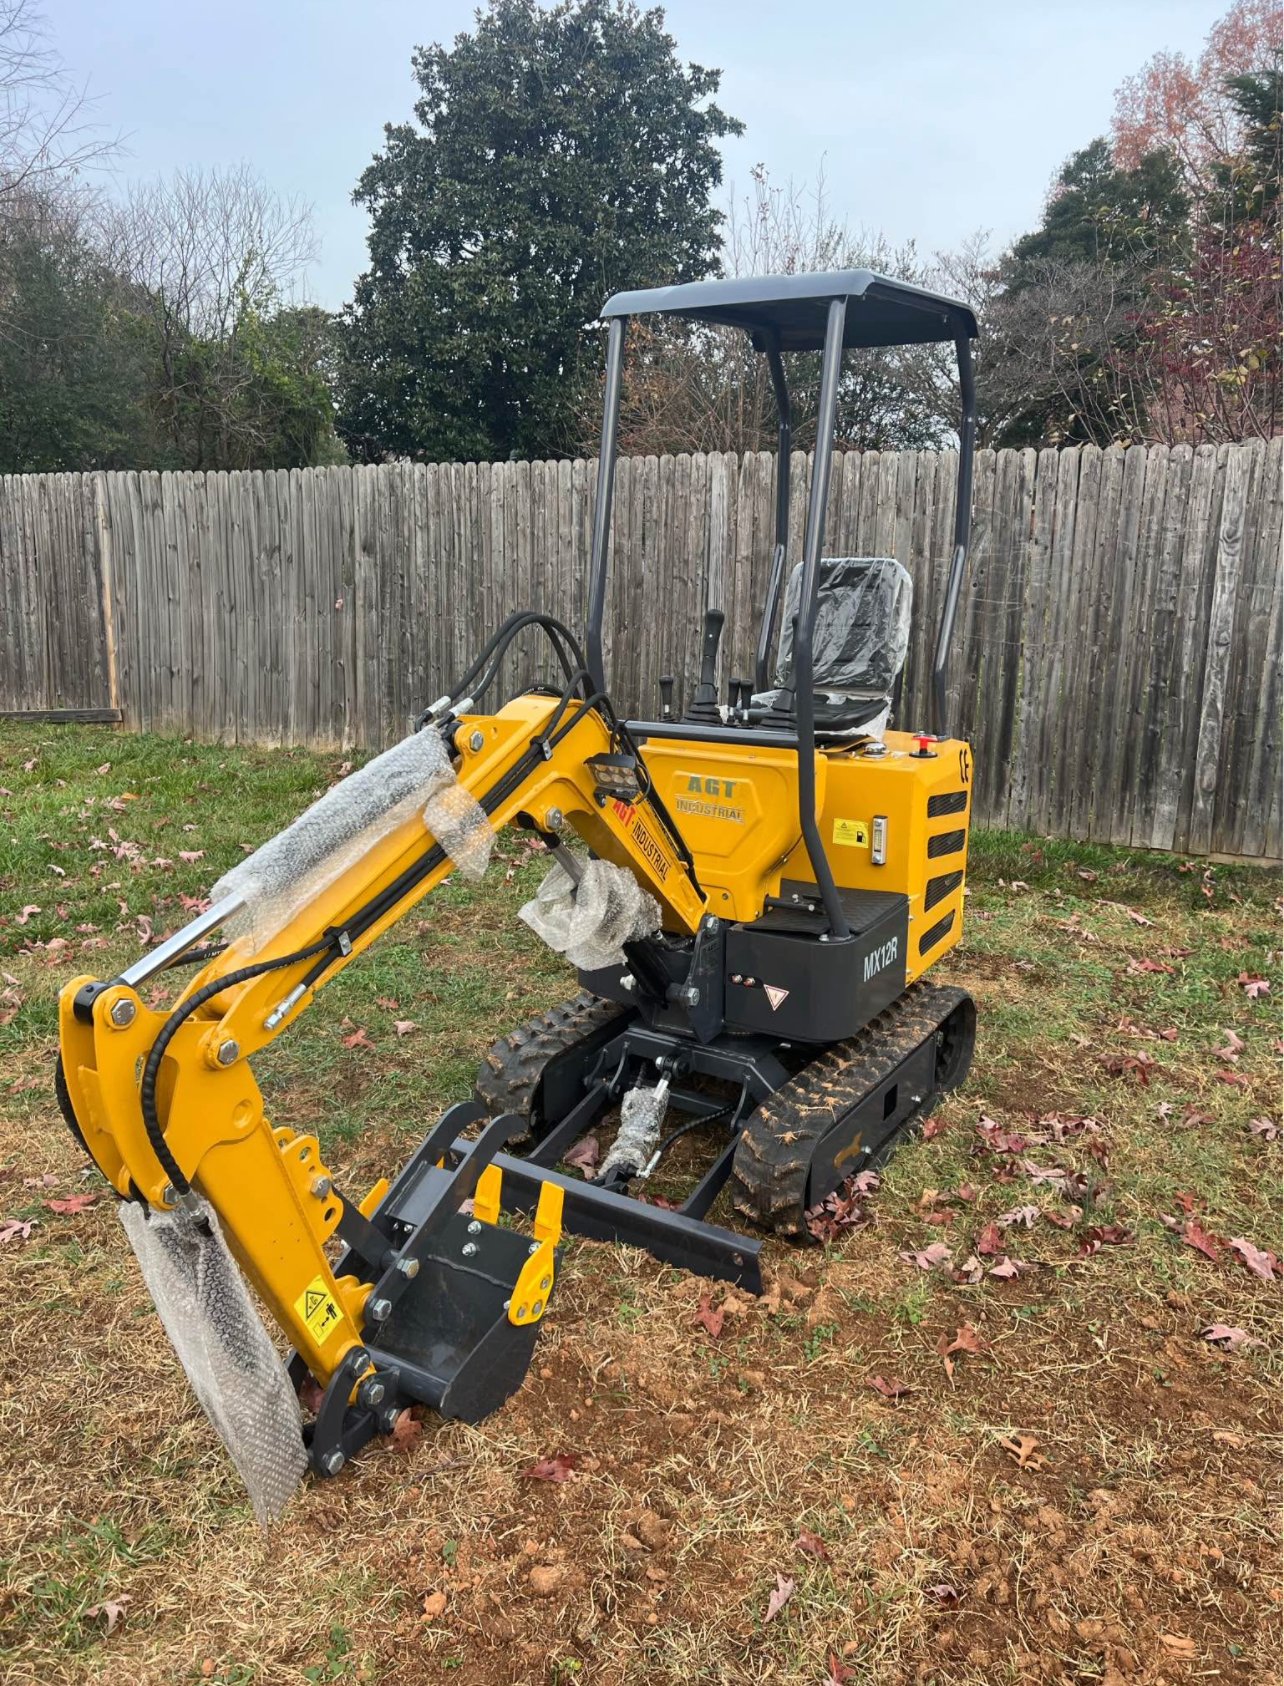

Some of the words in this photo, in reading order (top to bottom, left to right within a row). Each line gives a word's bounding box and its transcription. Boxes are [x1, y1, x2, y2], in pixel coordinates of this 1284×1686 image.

[687, 776, 736, 798] AGT
[676, 799, 742, 819] INDUSTRIAL
[612, 800, 637, 828] AGT
[632, 821, 669, 881] INDUSTRIAL
[863, 936, 898, 983] MX12R
